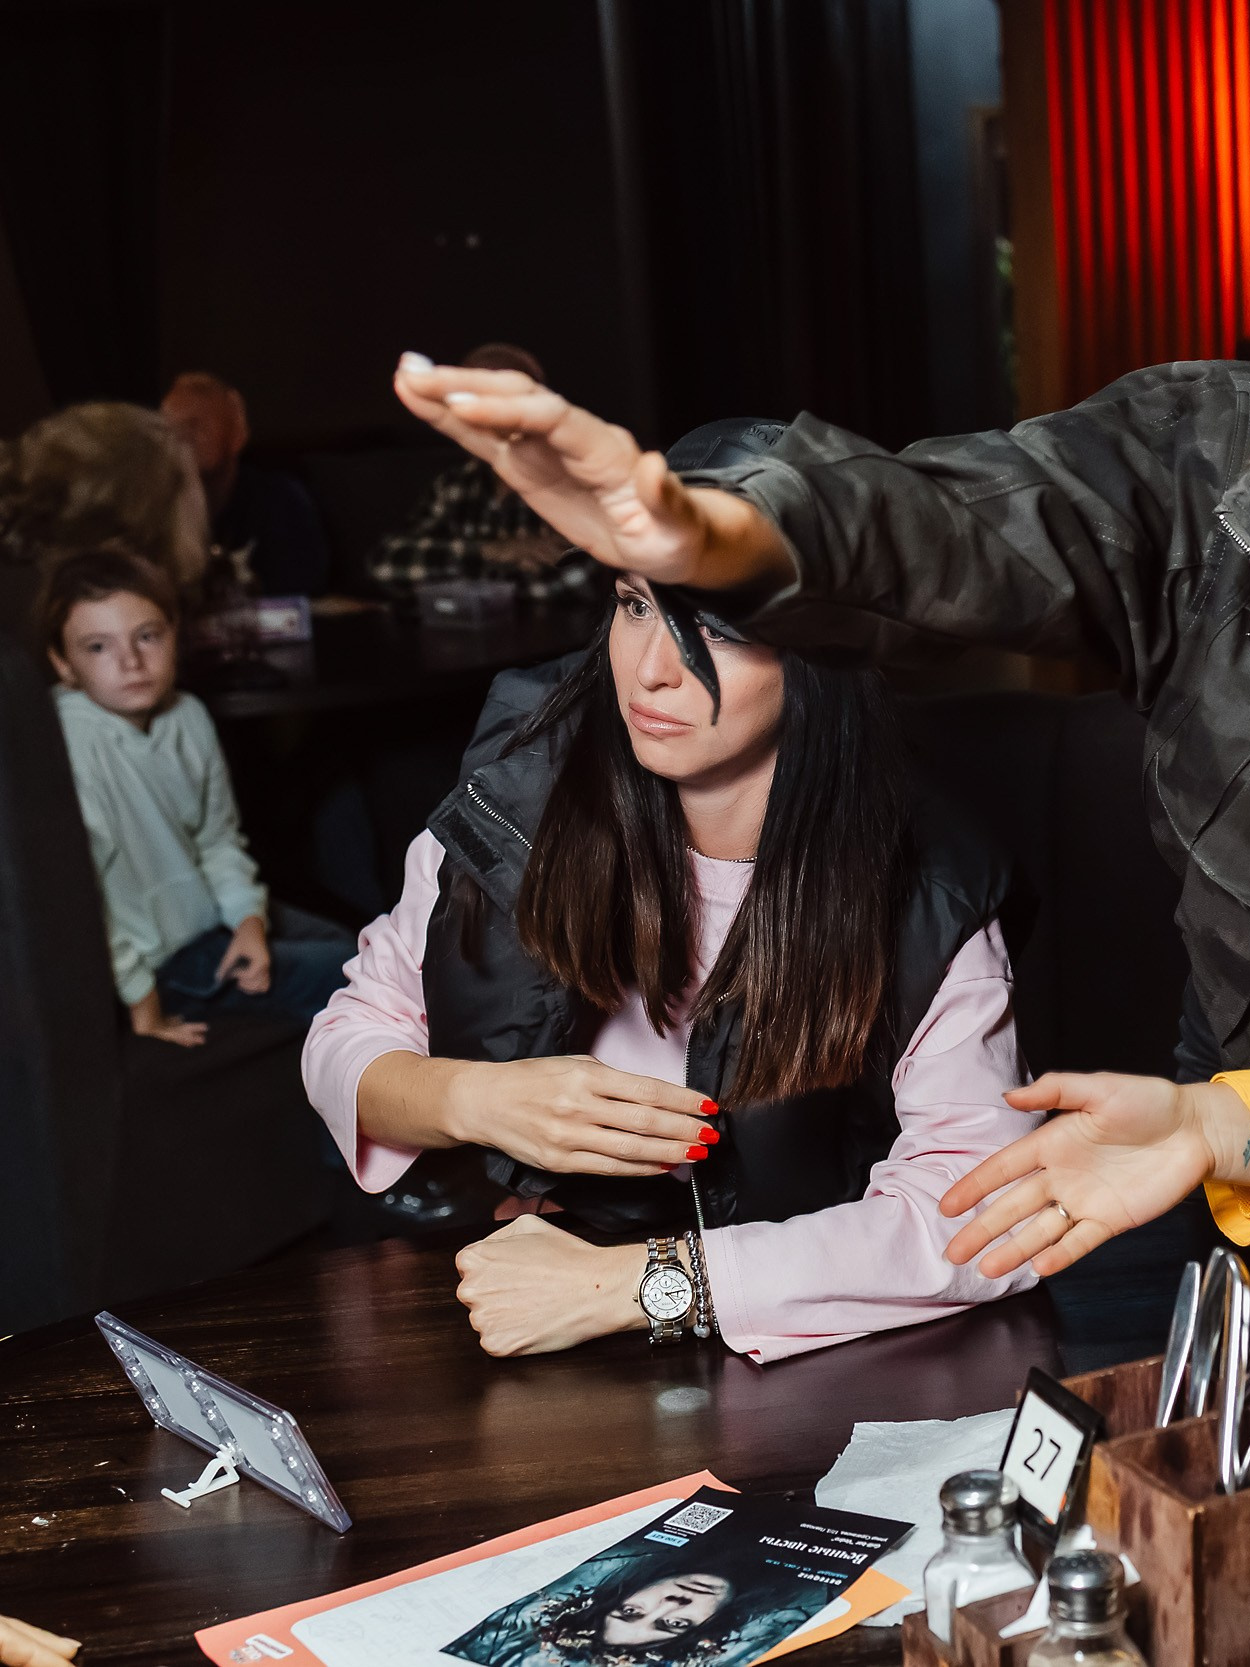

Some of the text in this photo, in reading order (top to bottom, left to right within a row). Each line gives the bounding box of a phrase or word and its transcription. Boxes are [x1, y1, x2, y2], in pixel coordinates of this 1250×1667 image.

[1023, 1427, 1062, 1481] 27
[758, 1535, 869, 1566] Вечные цветы
